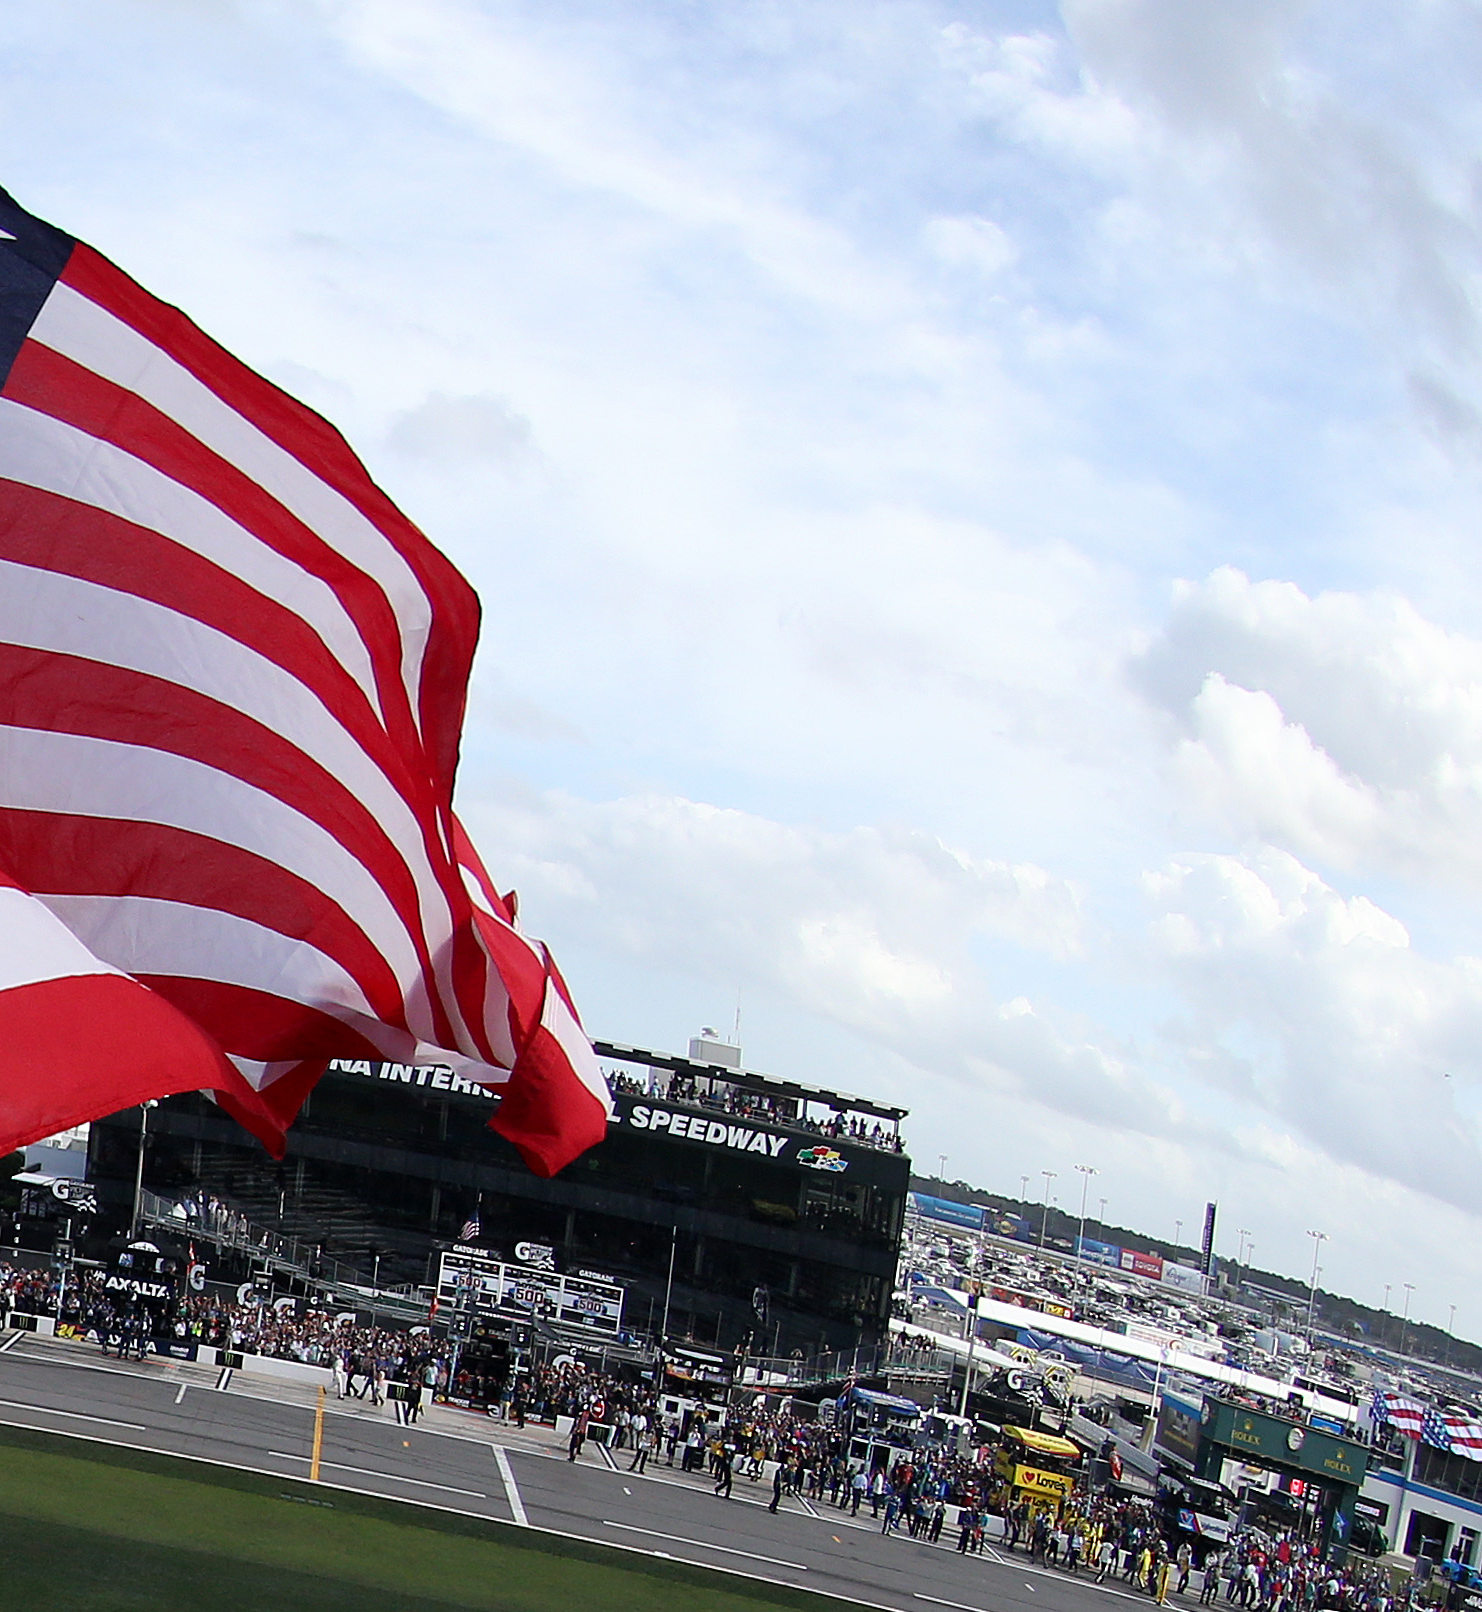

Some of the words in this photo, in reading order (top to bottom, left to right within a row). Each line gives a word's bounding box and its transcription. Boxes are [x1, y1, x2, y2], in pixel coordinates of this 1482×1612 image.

[629, 1105, 790, 1158] SPEEDWAY
[53, 1180, 70, 1199] G
[514, 1242, 531, 1260] G
[1135, 1259, 1160, 1275] TOYOTA
[189, 1264, 206, 1291] G
[579, 1269, 615, 1283] GATORADE
[106, 1276, 170, 1299] AXALTA
[516, 1288, 544, 1303] 500
[579, 1300, 601, 1314] 500
[58, 1324, 76, 1338] 24
[1007, 1369, 1023, 1390] G
[488, 1404, 503, 1418] 3
[1231, 1429, 1261, 1445] ROLEX
[1324, 1458, 1353, 1474] ROLEX
[1036, 1473, 1066, 1490] Love's
